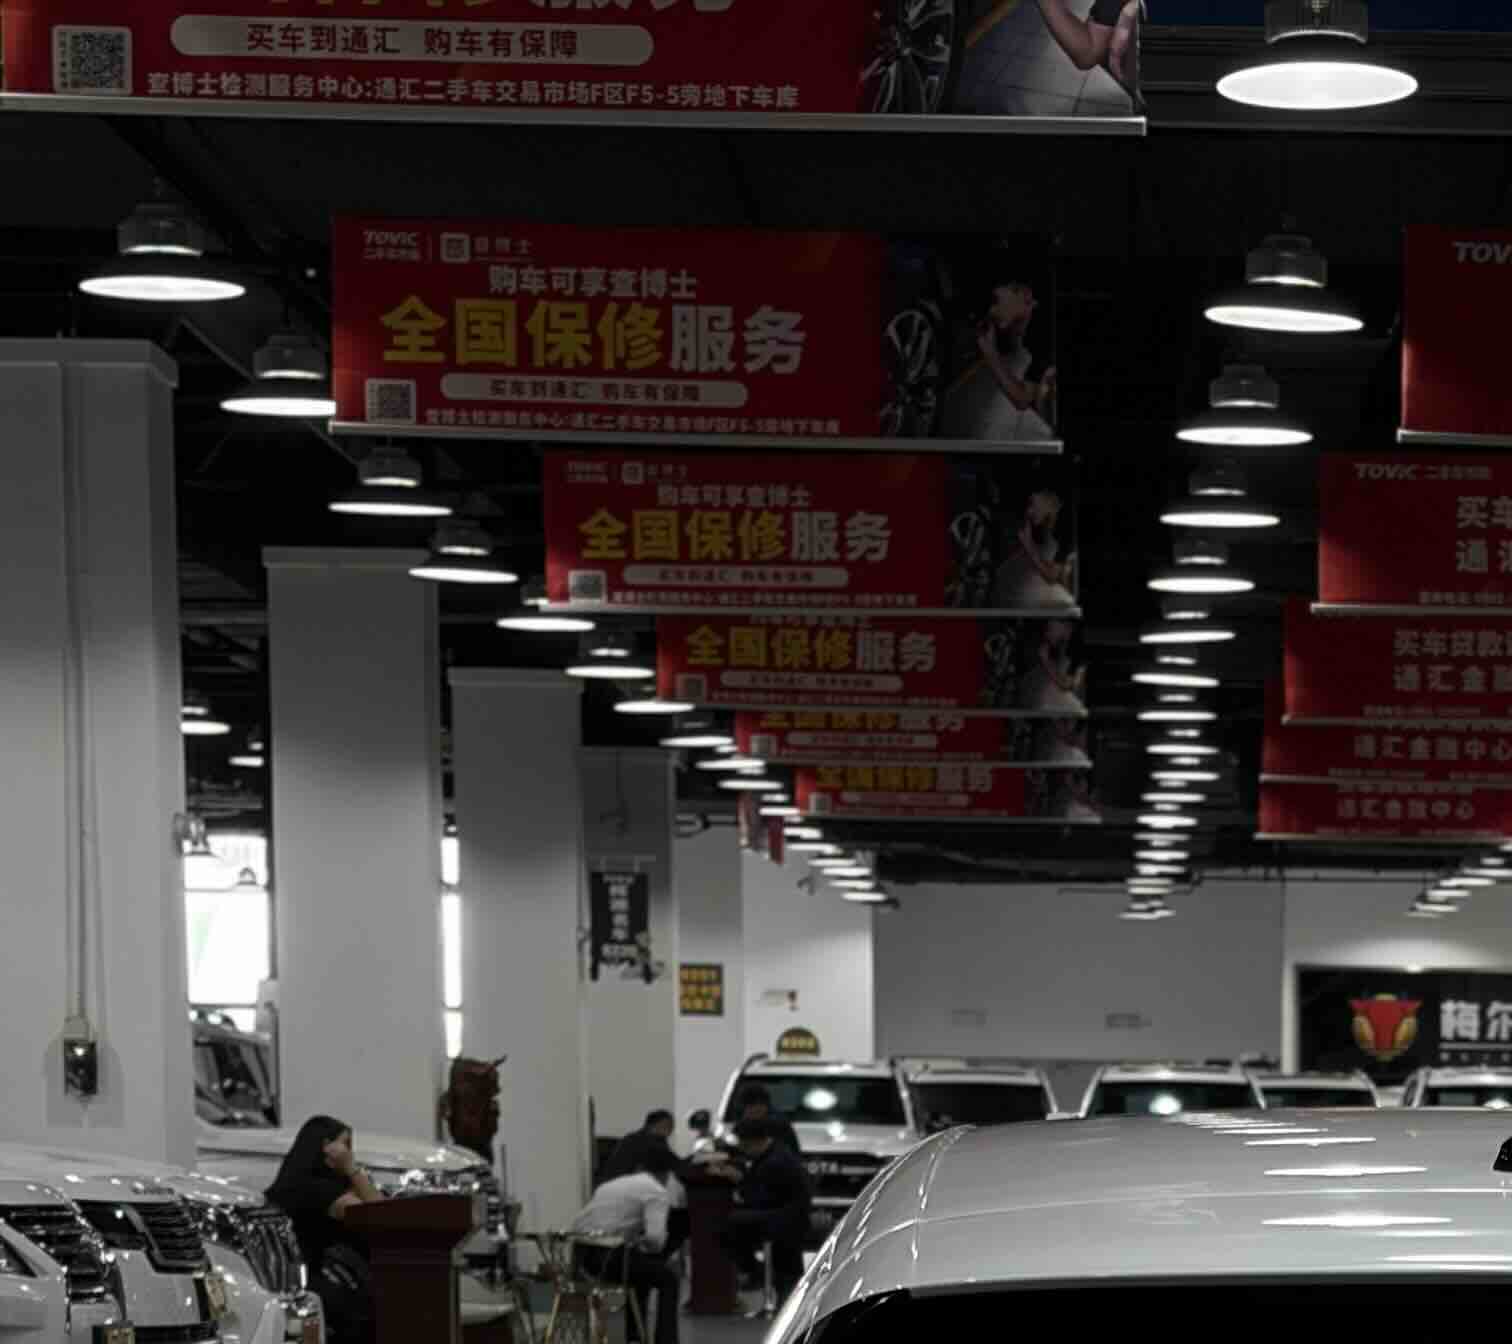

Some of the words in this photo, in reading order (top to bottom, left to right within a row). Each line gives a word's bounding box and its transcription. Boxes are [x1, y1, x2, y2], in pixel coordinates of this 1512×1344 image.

[247, 24, 400, 53] 买车到通汇
[424, 29, 577, 58] 购车有保障
[488, 265, 698, 300] 购车可享查博士
[380, 297, 808, 374] 全国保修服务
[577, 508, 892, 563] 全国保修服务
[685, 624, 937, 673] 全国保修服务
